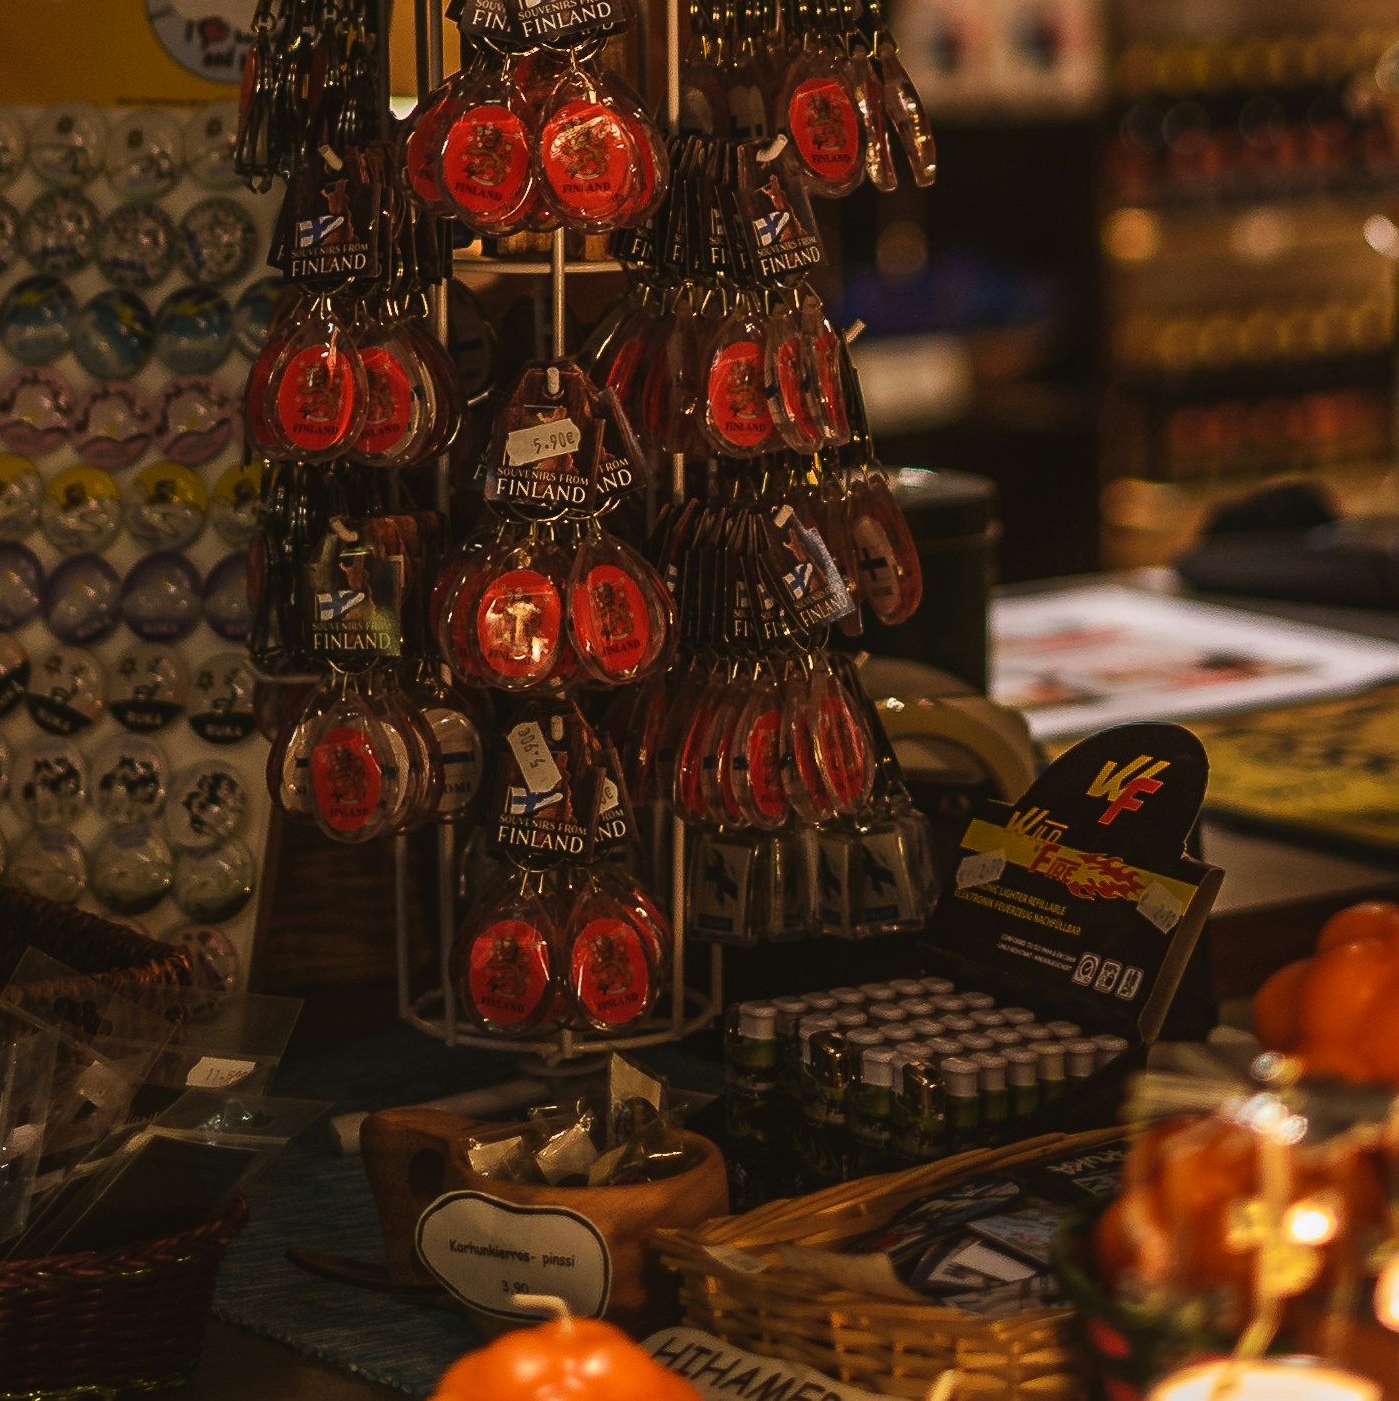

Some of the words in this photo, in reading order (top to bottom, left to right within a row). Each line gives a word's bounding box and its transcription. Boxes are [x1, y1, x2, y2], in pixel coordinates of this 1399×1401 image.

[521, 2, 613, 39] FINLAND
[811, 154, 851, 165] FINLAND
[454, 180, 503, 201] FINLAND
[562, 181, 611, 194] FINLAND
[291, 244, 340, 258] SOUVENIRS
[342, 242, 369, 252] FROM
[759, 245, 821, 277] FINLAND
[291, 252, 367, 277] FINLAND
[292, 422, 339, 436] FINLAND
[725, 421, 766, 433] FINLAND
[533, 430, 575, 455] 5.90€
[496, 466, 556, 482] SOUVENIRS
[557, 472, 589, 487] FROM
[496, 478, 587, 504] FINLAND
[799, 592, 849, 628] FINLAND
[313, 632, 391, 651] FINLAND
[517, 727, 547, 769] 5.90€
[1085, 754, 1171, 826] WF
[329, 806, 370, 817] FINLAND
[601, 808, 626, 822] ROM
[498, 813, 556, 831] SOUVENIRS
[557, 821, 588, 836] FROM
[497, 825, 584, 854] FINLAND
[448, 1238, 536, 1264] Karhunkierros-
[542, 1251, 575, 1269] pinssi
